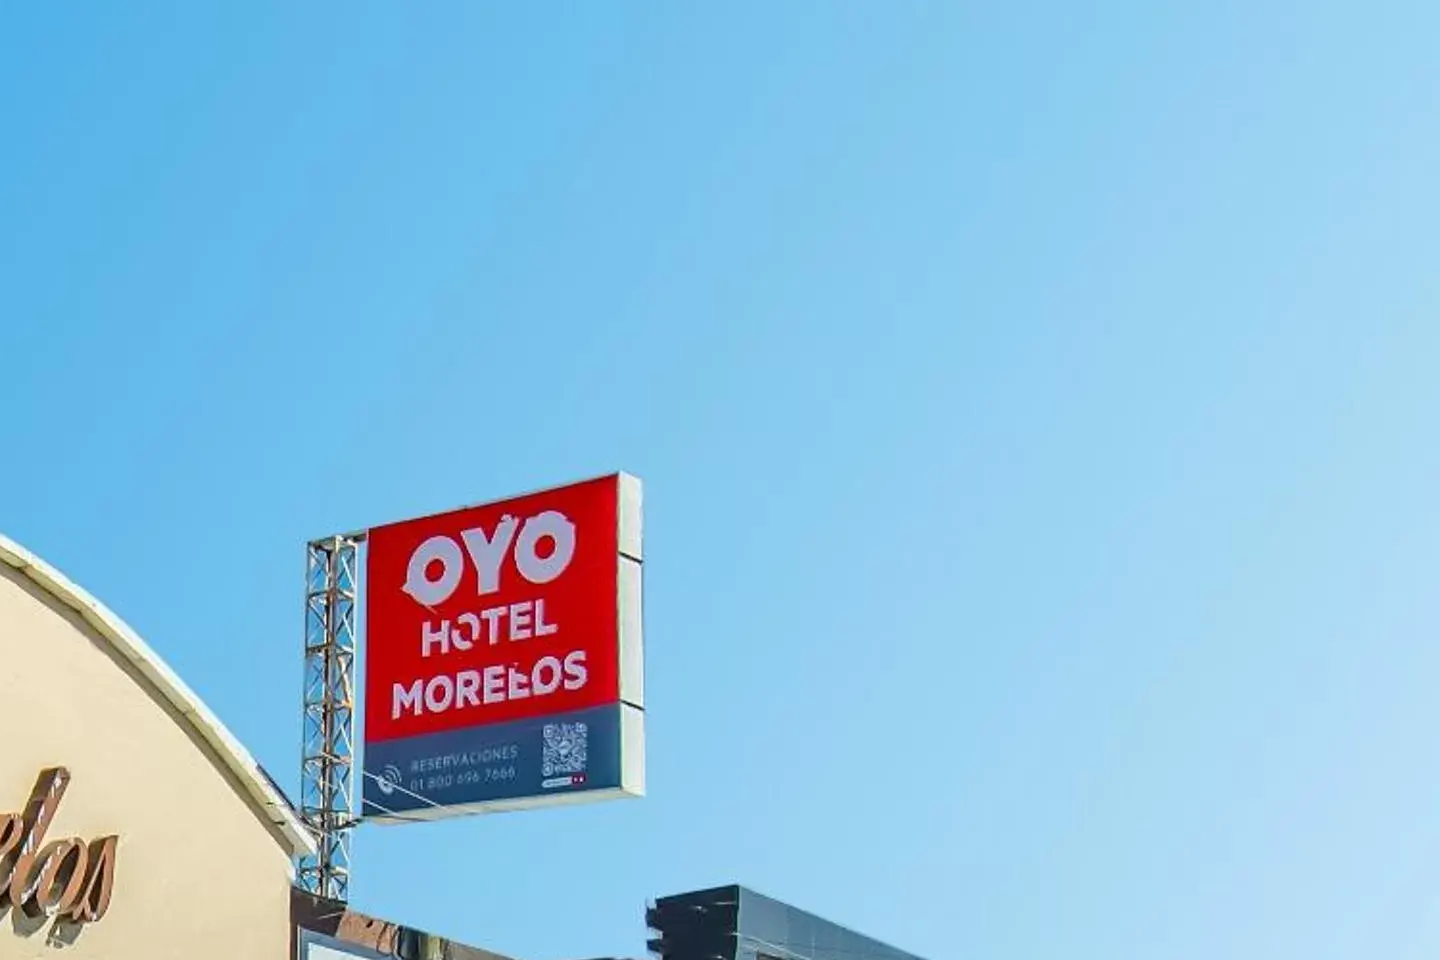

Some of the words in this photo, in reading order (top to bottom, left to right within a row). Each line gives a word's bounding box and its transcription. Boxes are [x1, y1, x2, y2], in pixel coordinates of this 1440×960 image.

[401, 511, 576, 606] OYO
[421, 598, 558, 657] HOTEL
[391, 650, 588, 720] MORELOS
[411, 744, 519, 773] RESERVACIONES
